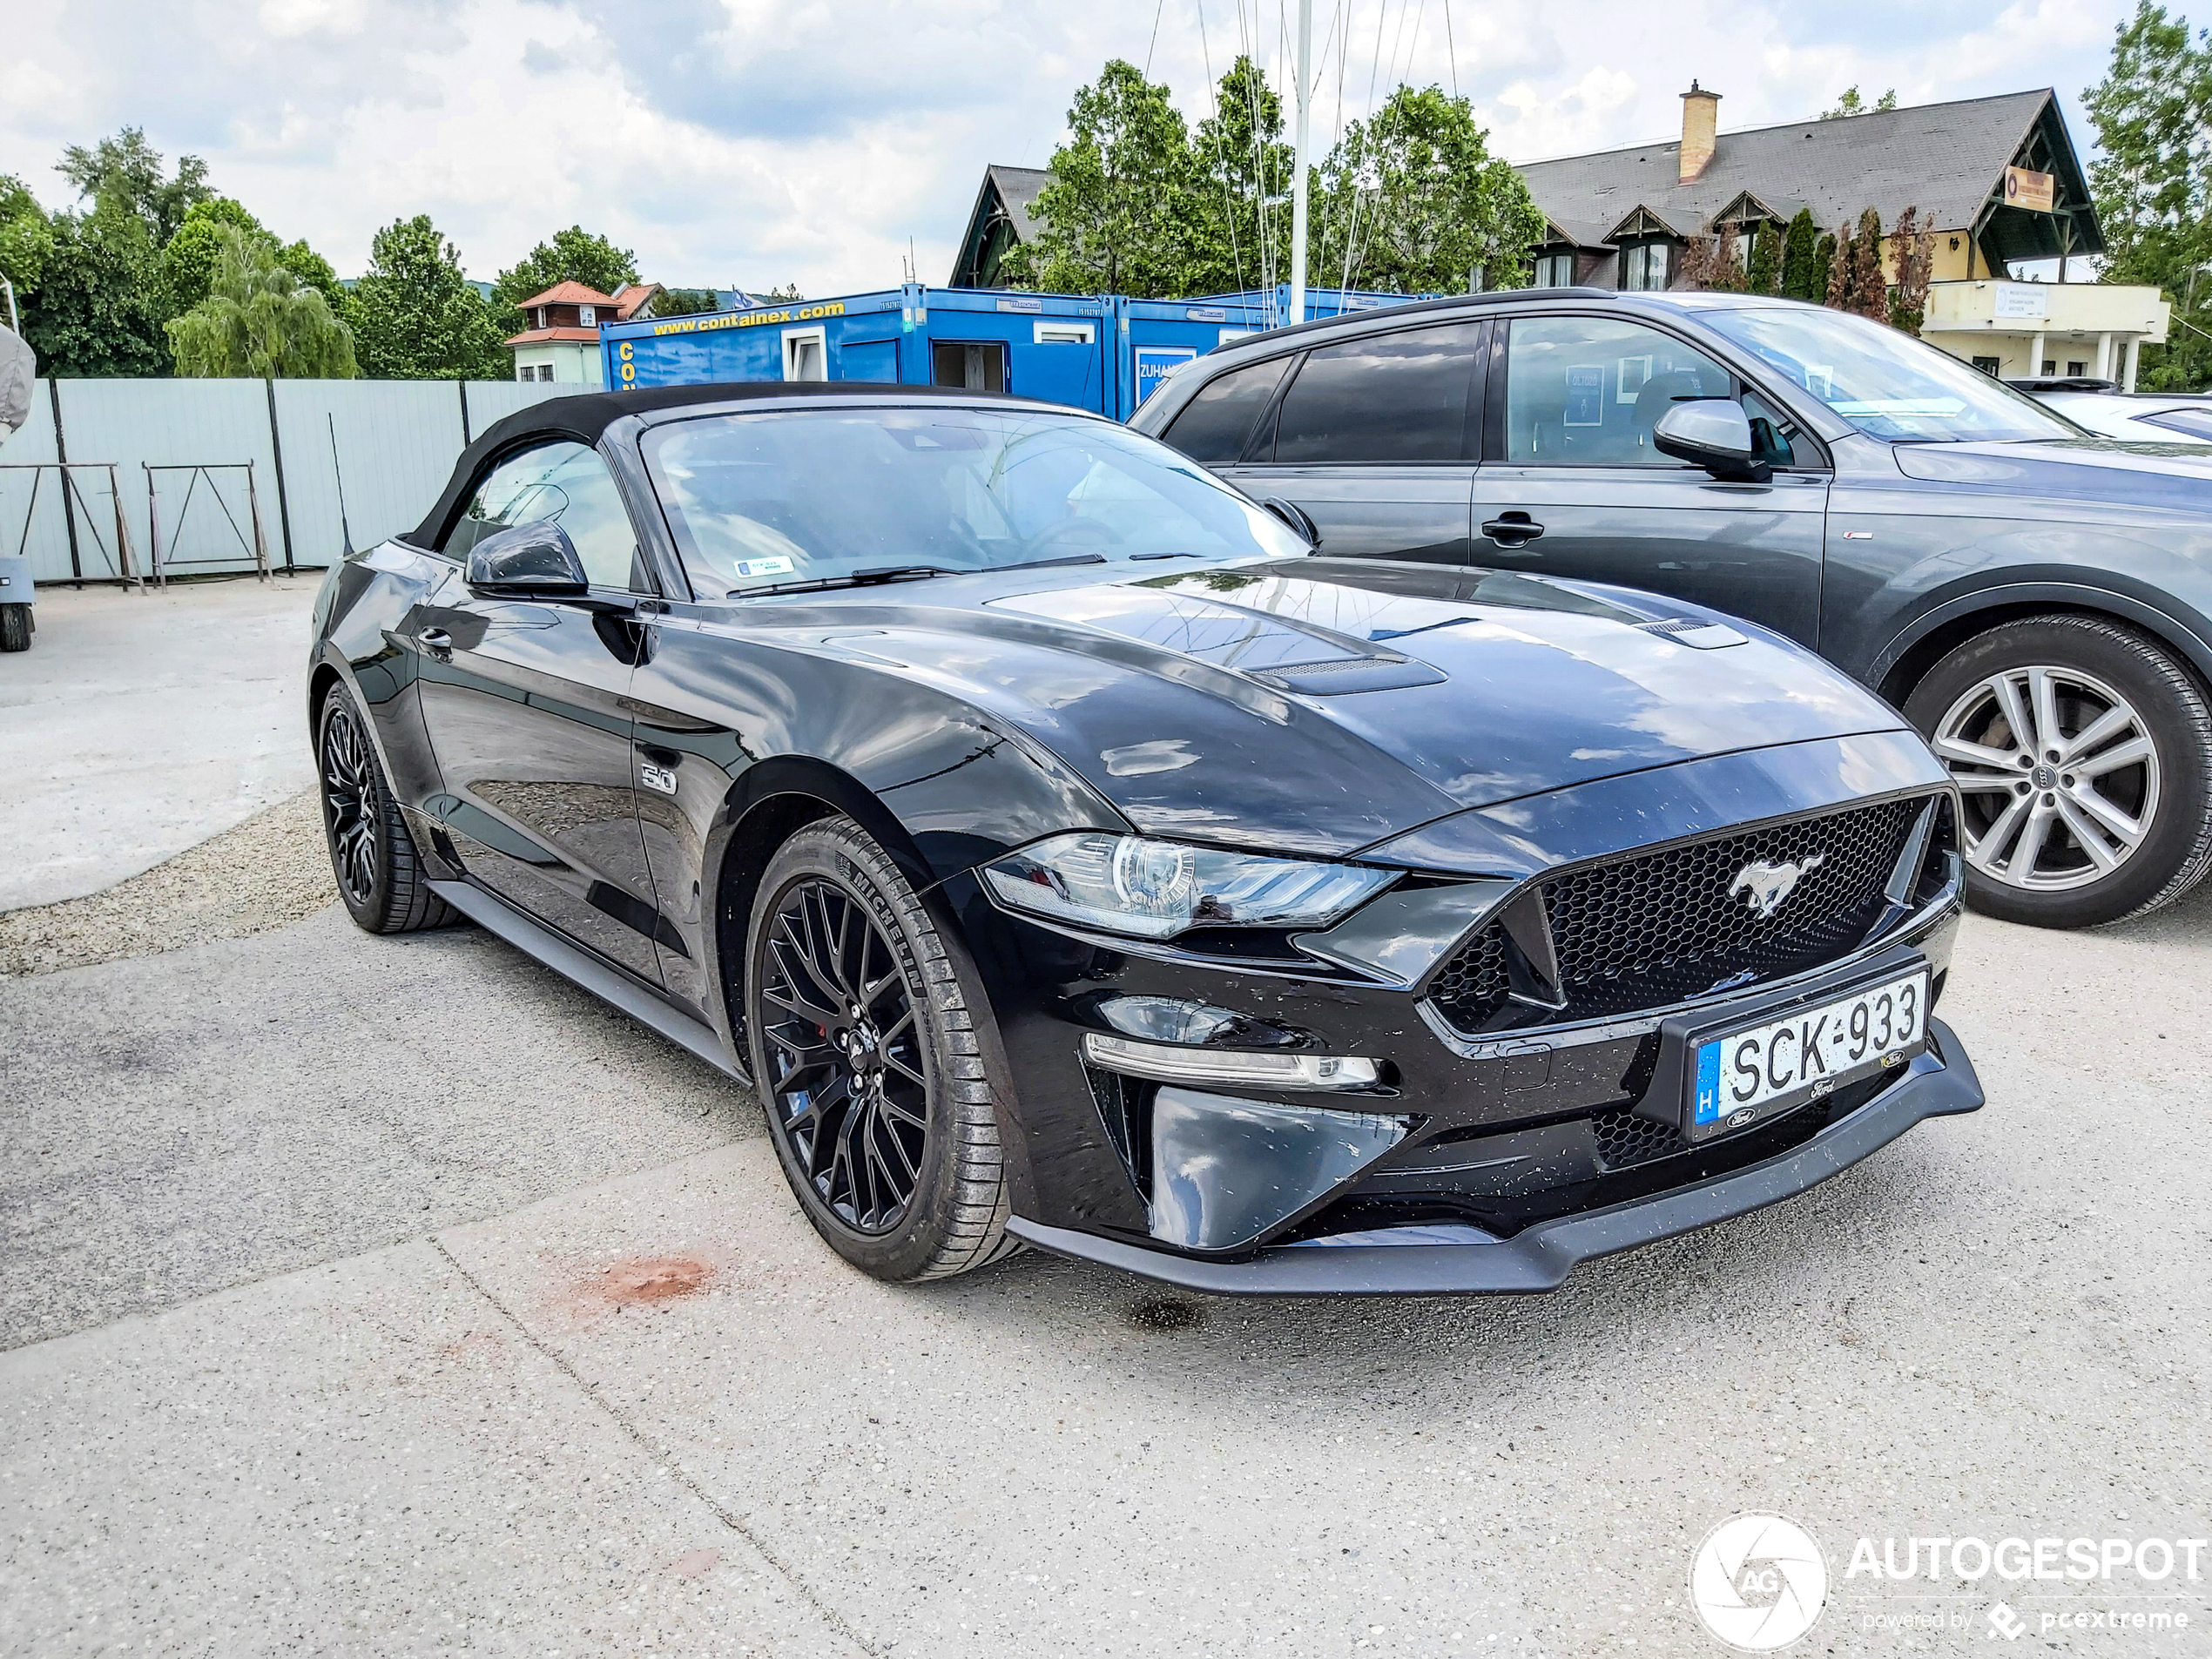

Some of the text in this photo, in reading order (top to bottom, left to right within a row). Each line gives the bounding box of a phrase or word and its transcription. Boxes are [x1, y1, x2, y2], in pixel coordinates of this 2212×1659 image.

[853, 872, 922, 990] MICHELIN
[1699, 983, 1916, 1114] H SCK-933
[1730, 1111, 1752, 1127] Ford
[1811, 1079, 1835, 1099] Ford
